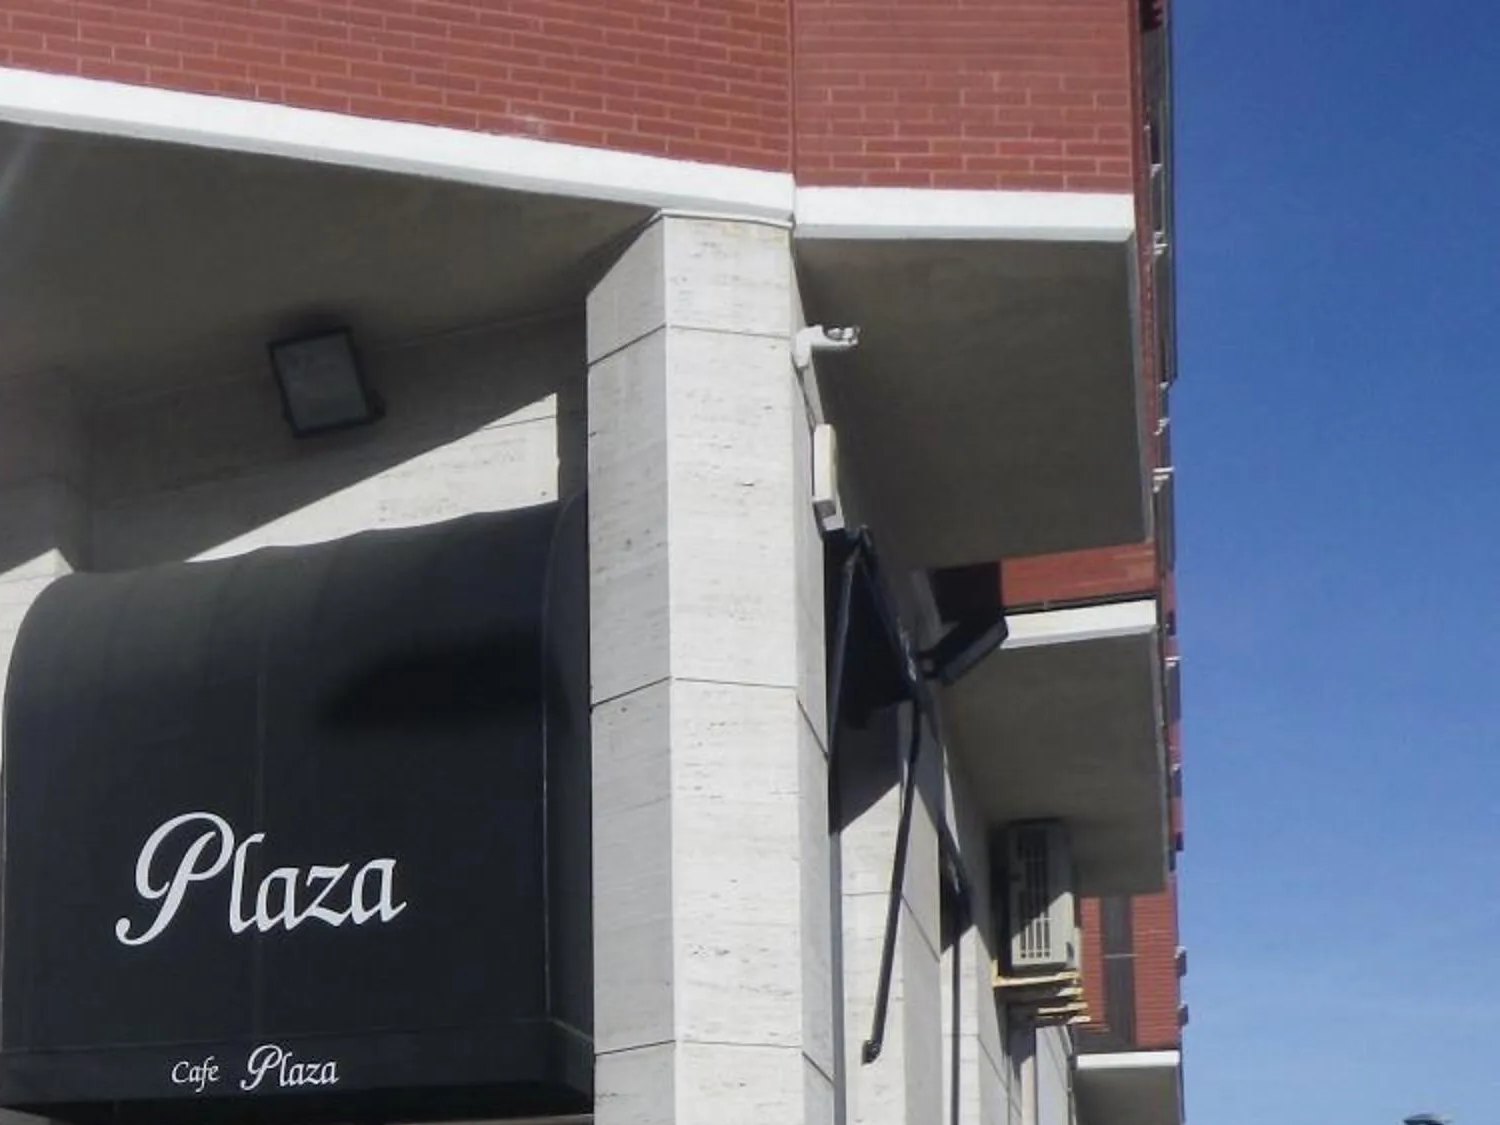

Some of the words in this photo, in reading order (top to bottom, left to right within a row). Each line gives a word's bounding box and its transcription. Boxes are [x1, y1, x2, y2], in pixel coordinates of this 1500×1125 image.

[115, 811, 407, 945] Plaza
[171, 1056, 220, 1092] Cafe
[240, 1044, 339, 1091] Plaza
